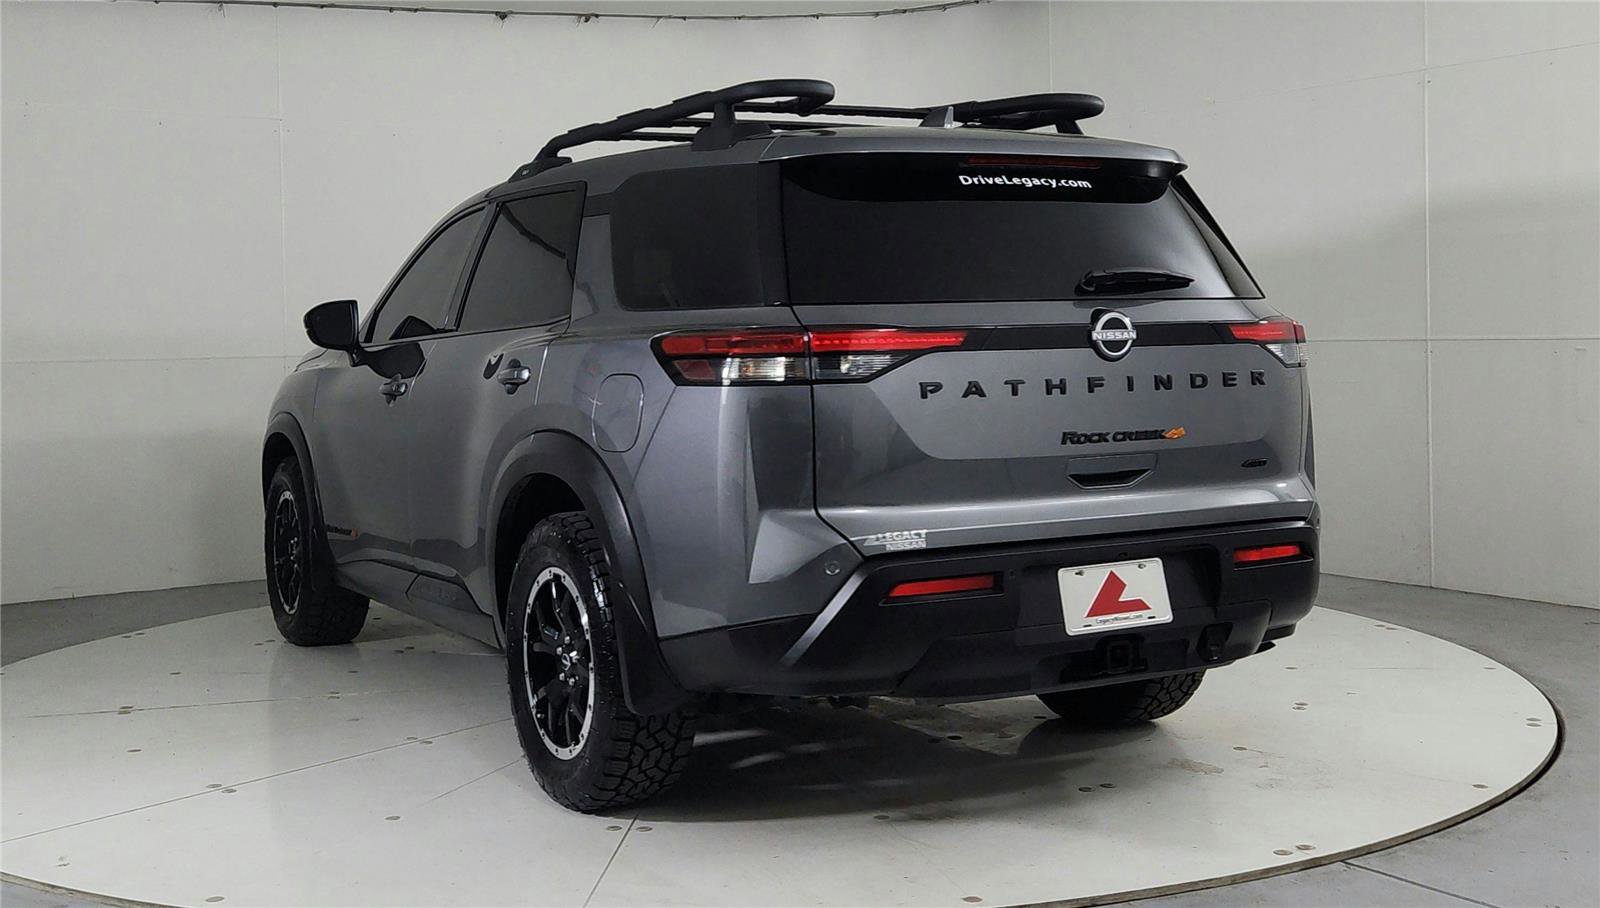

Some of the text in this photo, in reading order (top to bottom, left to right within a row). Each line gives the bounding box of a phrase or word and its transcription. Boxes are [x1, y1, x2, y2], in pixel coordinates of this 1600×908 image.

[959, 175, 1092, 188] DriveLegacy.com
[1092, 330, 1137, 340] NISSAN
[919, 369, 1267, 400] PATHFINDER
[878, 529, 928, 542] LEGACY
[885, 540, 927, 552] NISSAN
